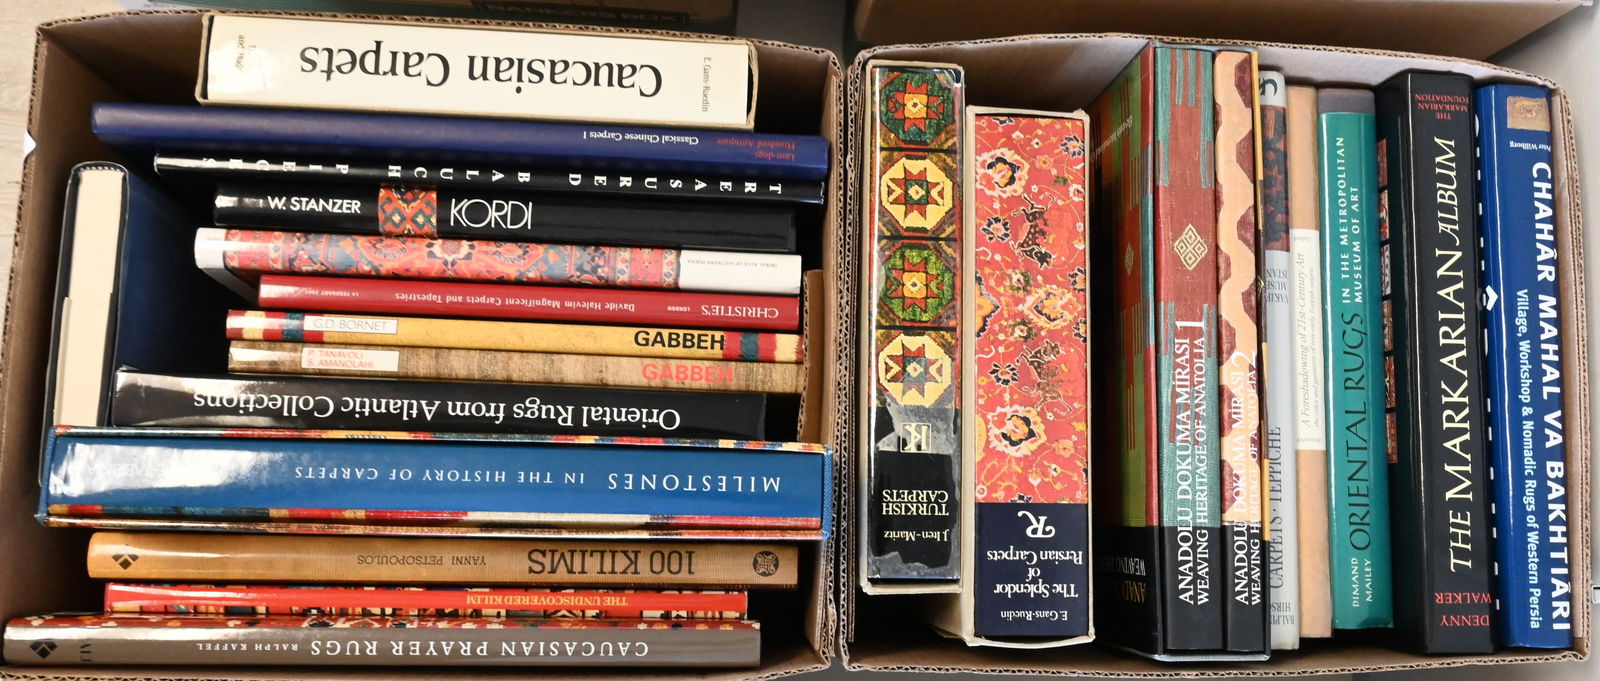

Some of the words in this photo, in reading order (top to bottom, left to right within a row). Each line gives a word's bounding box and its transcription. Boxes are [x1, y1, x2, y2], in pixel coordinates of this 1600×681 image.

[299, 40, 450, 87] Carpets
[467, 55, 662, 97] Caucasian
[1415, 94, 1469, 104] FOUNDATION
[1417, 102, 1468, 113] MARKARIAN
[1436, 111, 1452, 120] THE
[589, 131, 622, 142] Carpets
[625, 133, 659, 144] Chinese
[662, 135, 699, 145] Classical
[716, 136, 755, 147] Antiques
[757, 139, 797, 150] Hundred
[1510, 140, 1538, 150] Willborg
[756, 149, 797, 161] Lion-dogs
[388, 165, 532, 183] BALUCH
[568, 173, 782, 194] TREASURED
[1336, 137, 1349, 246] METROPOLITAN
[1433, 136, 1460, 247] ALBUM
[1350, 186, 1360, 212] ART
[267, 196, 287, 210] W.
[290, 196, 361, 214] STANZER
[450, 198, 533, 229] KORDI
[1532, 161, 1558, 282] CHAHÂR
[1351, 217, 1361, 235] OF
[1296, 252, 1305, 268] Art
[1341, 252, 1350, 280] THE
[1353, 240, 1363, 304] MUSEUM
[395, 292, 442, 304] Tapestries
[446, 295, 463, 304] and
[466, 295, 502, 306] Carpets
[509, 297, 561, 309] Magnificent
[1296, 269, 1307, 330] 21st-Century
[1342, 287, 1351, 304] IN
[565, 299, 601, 311] Halevim
[605, 301, 635, 312] Davide
[701, 303, 779, 319] CHRISTIE'S
[1516, 289, 1530, 337] Village,
[339, 319, 386, 332] BORNET
[1175, 320, 1205, 329] 1
[634, 330, 725, 350] GABBEH
[1297, 332, 1308, 343] of
[1341, 312, 1368, 390] RUGS
[1538, 293, 1562, 401] MAHAL
[1231, 351, 1257, 368] 2
[642, 363, 733, 383] GABBEH
[1172, 338, 1190, 404] MİRASI
[1193, 338, 1207, 416] ANATOLIA
[1435, 247, 1473, 502] MARKARIAN
[1518, 340, 1533, 402] Workshop
[1298, 345, 1310, 416] Foreshadowing
[194, 392, 334, 418] Collections
[341, 397, 441, 421] Atlantic
[447, 401, 505, 424] from
[513, 397, 575, 427] Rugs
[1522, 407, 1533, 417] &
[582, 405, 681, 430] Oriental
[1300, 418, 1311, 428] A
[1194, 419, 1207, 443] OF
[1543, 410, 1563, 449] VA
[1176, 410, 1193, 499] DOKUMA
[1250, 442, 1259, 461] OF
[1522, 421, 1535, 474] Nomadic
[295, 466, 378, 480] CARPETS
[390, 469, 412, 481] OF
[423, 469, 506, 483] HISTORY
[518, 471, 553, 484] THE
[564, 472, 584, 484] IN
[1232, 435, 1246, 513] DOKUMA
[1345, 401, 1371, 550] ORIENTAL
[608, 473, 781, 492] MILESTONES
[1195, 445, 1208, 523] HERITAGE
[883, 489, 949, 503] CARPETS
[1249, 467, 1261, 534] HERITAGE
[1522, 480, 1536, 504] Rugs
[882, 503, 949, 516] TURKISH
[1526, 510, 1538, 527] of
[1017, 510, 1056, 538] R
[1449, 509, 1472, 573] THE
[357, 554, 443, 566] PETSOPOULOS
[451, 555, 486, 566] YANNI
[528, 548, 641, 575] KILIMS
[650, 550, 696, 575] 100
[986, 545, 1038, 565] Carpets
[1040, 550, 1083, 565] Persian
[1177, 507, 1194, 605] ANADOLU
[1233, 520, 1249, 605] ANADOLU
[1527, 529, 1540, 585] Western
[1026, 567, 1041, 582] of
[1196, 529, 1210, 605] WEAVING
[1250, 539, 1261, 605] WEAVING
[993, 578, 1050, 598] Splendor
[1351, 557, 1360, 608] DIMAND
[1363, 558, 1373, 602] MAILEY
[1052, 583, 1079, 598] The
[1434, 591, 1491, 605] WALKER
[466, 595, 502, 605] KILIM
[504, 595, 603, 606] UNDISCOVERED
[603, 596, 629, 606] THE
[1530, 588, 1543, 629] Persia
[1001, 610, 1059, 621] Gans-Ruedin
[1440, 614, 1490, 627] DENNY
[196, 642, 248, 651] KAFFEL
[254, 643, 299, 651] RALPH
[310, 639, 378, 656] RUGS
[391, 640, 488, 656] PRAYER
[500, 640, 649, 656] CAUCASIAN
